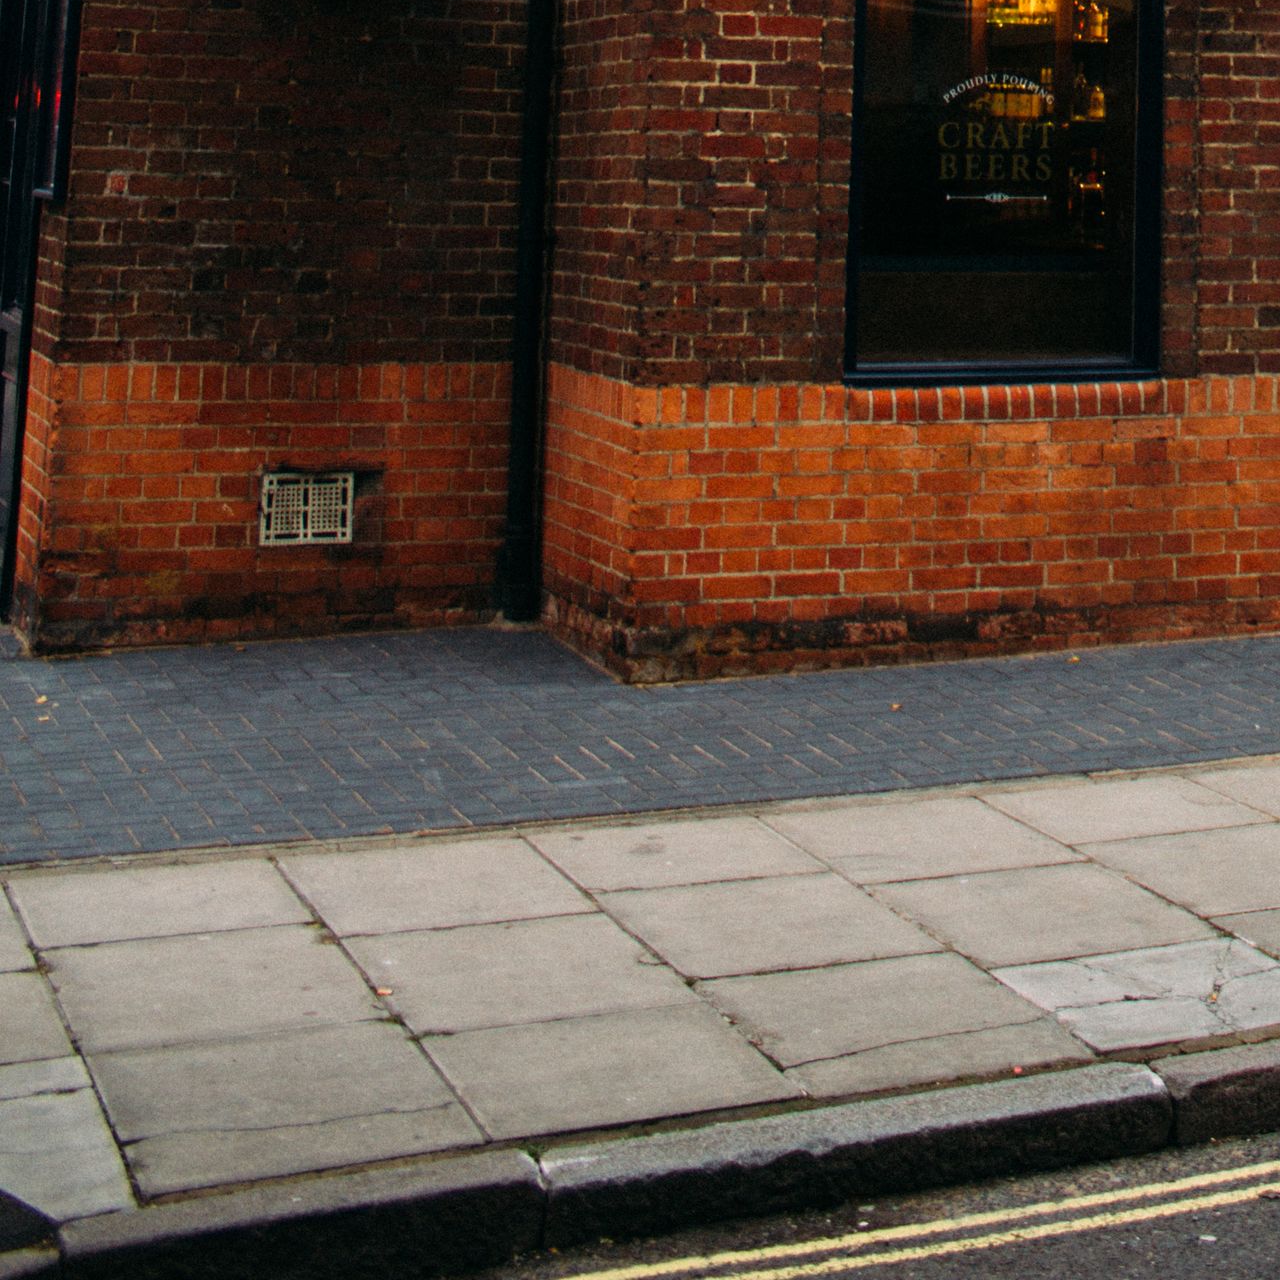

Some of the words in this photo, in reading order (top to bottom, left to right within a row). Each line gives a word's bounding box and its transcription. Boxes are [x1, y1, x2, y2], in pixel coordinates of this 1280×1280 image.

[942, 73, 998, 104] PROUDLY
[1002, 73, 1056, 104] POURING
[937, 121, 1056, 150] CRAFT
[938, 153, 1053, 182] BEERS
